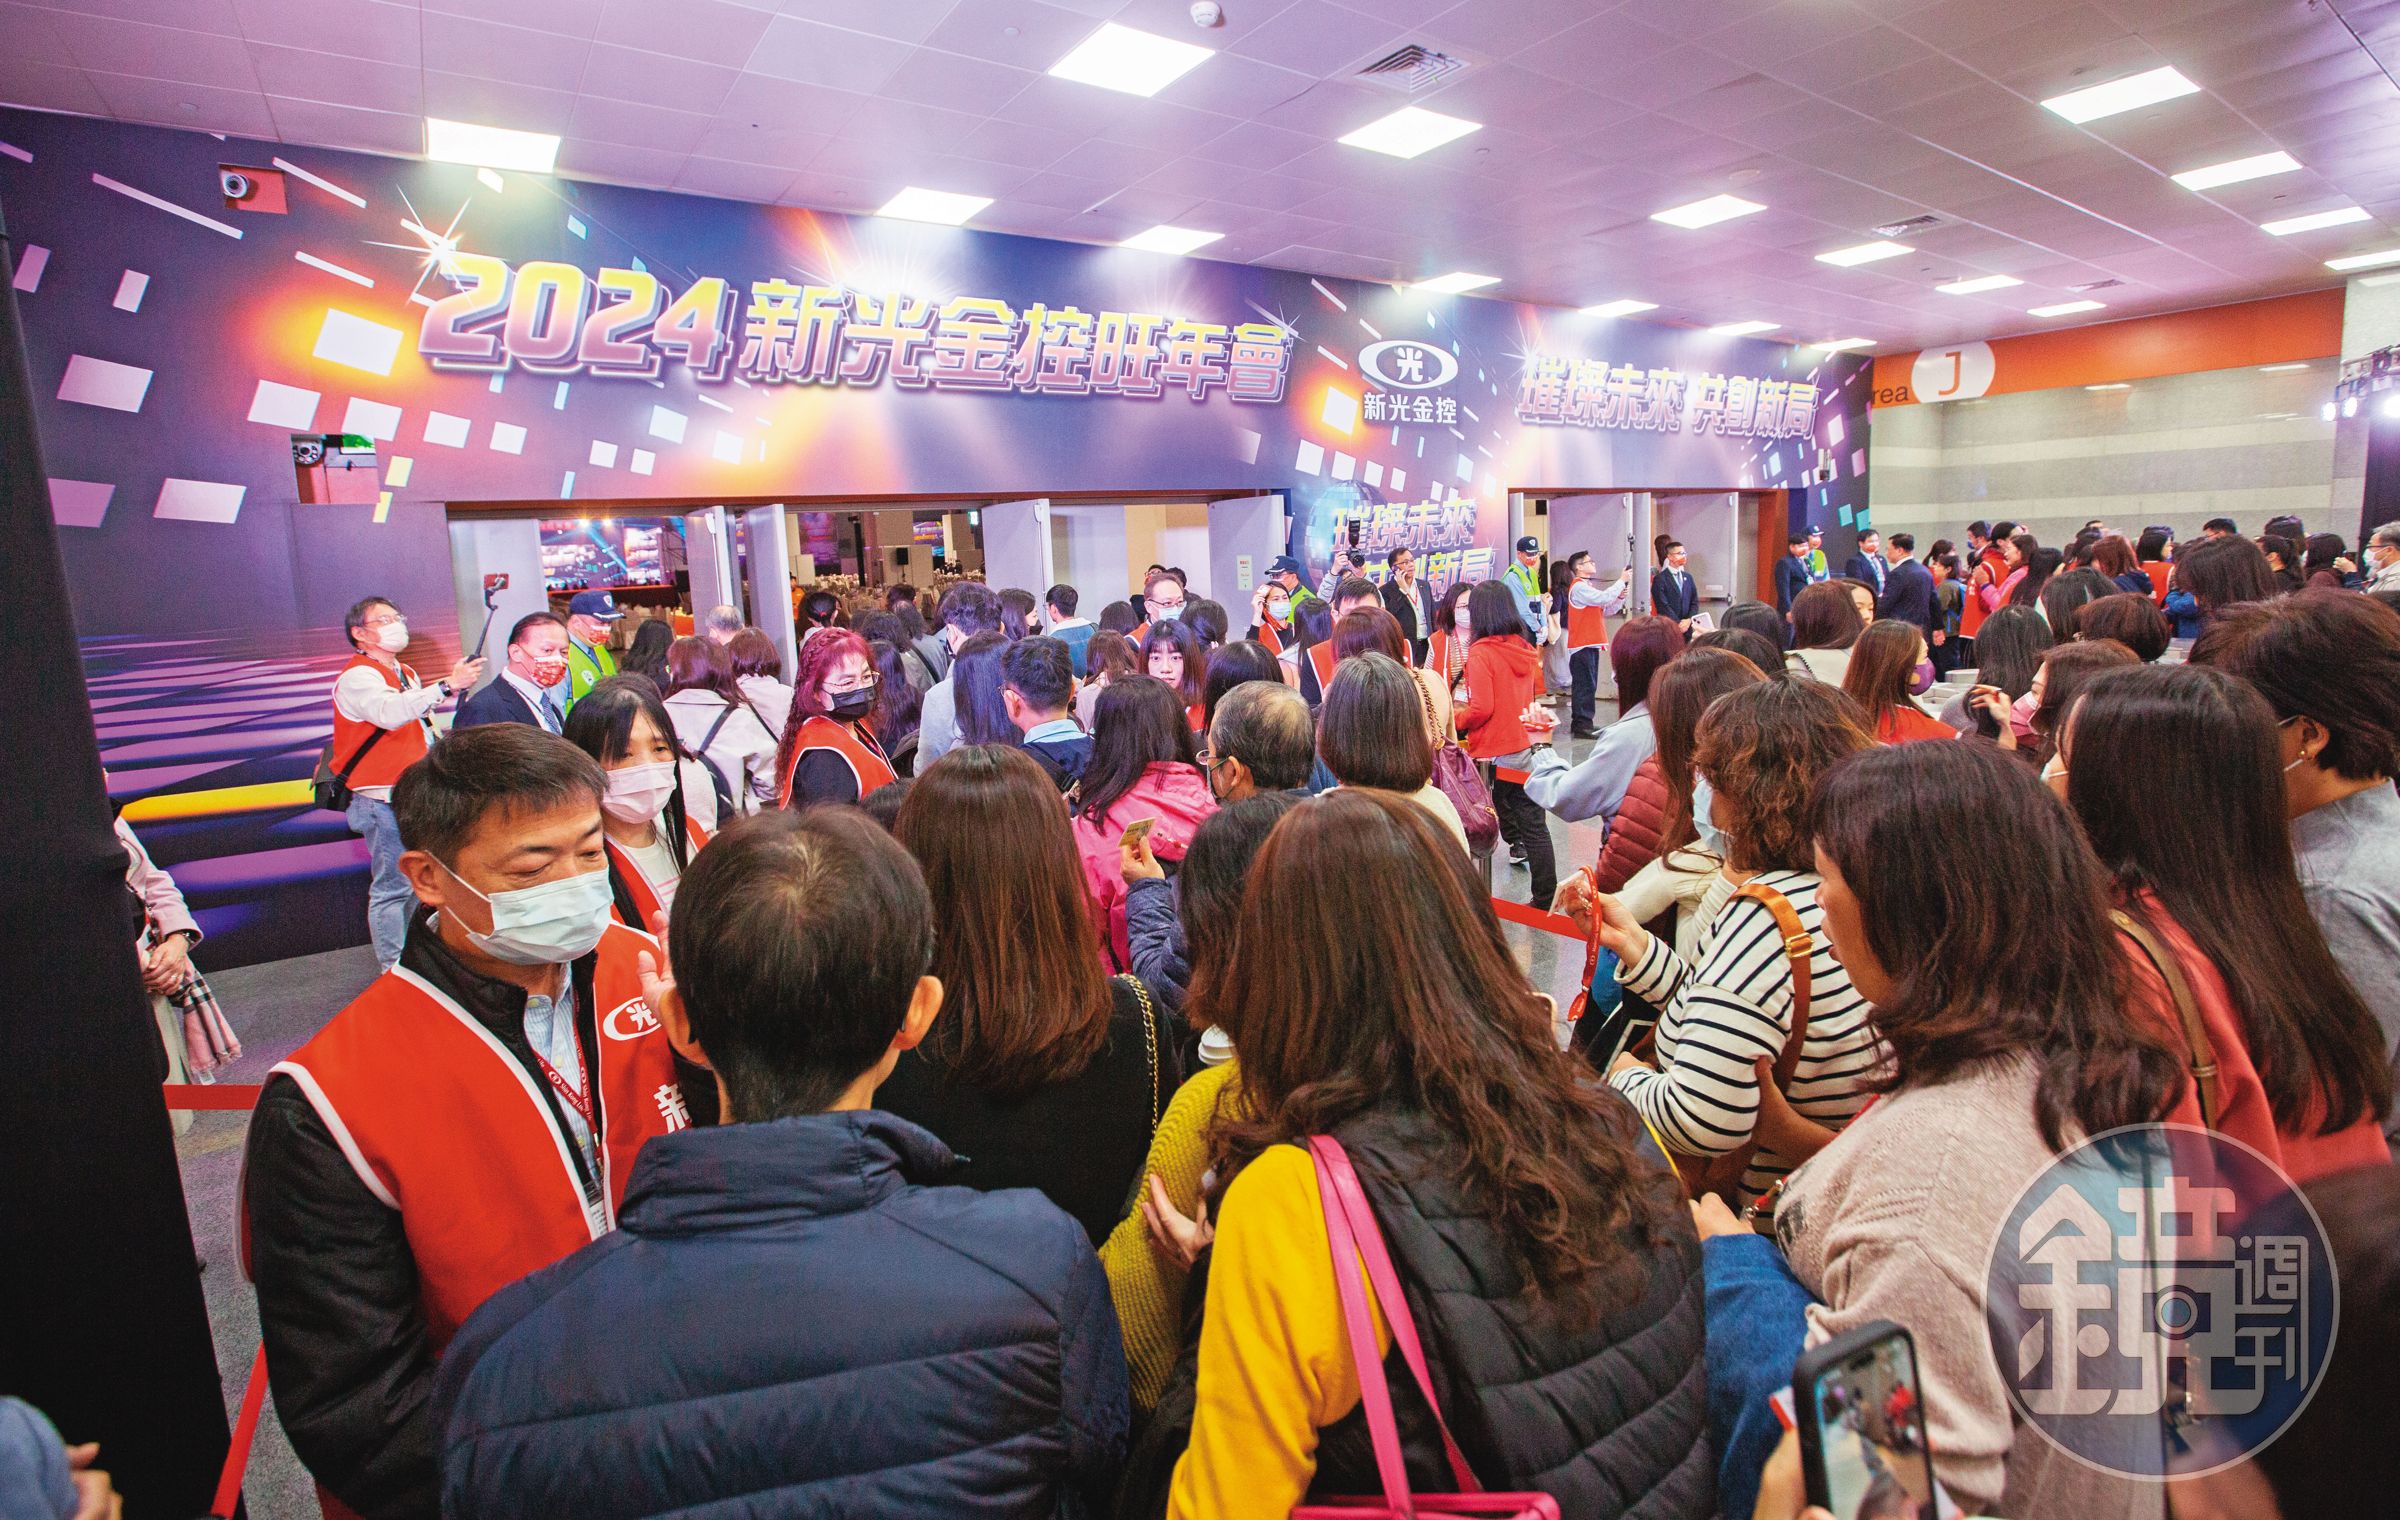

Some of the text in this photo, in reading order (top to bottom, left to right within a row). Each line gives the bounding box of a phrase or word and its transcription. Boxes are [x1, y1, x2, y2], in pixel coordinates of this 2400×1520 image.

[1872, 351, 1961, 404] rea J
[1364, 392, 1457, 424] 新光金控
[1694, 372, 1819, 439] 共創新局
